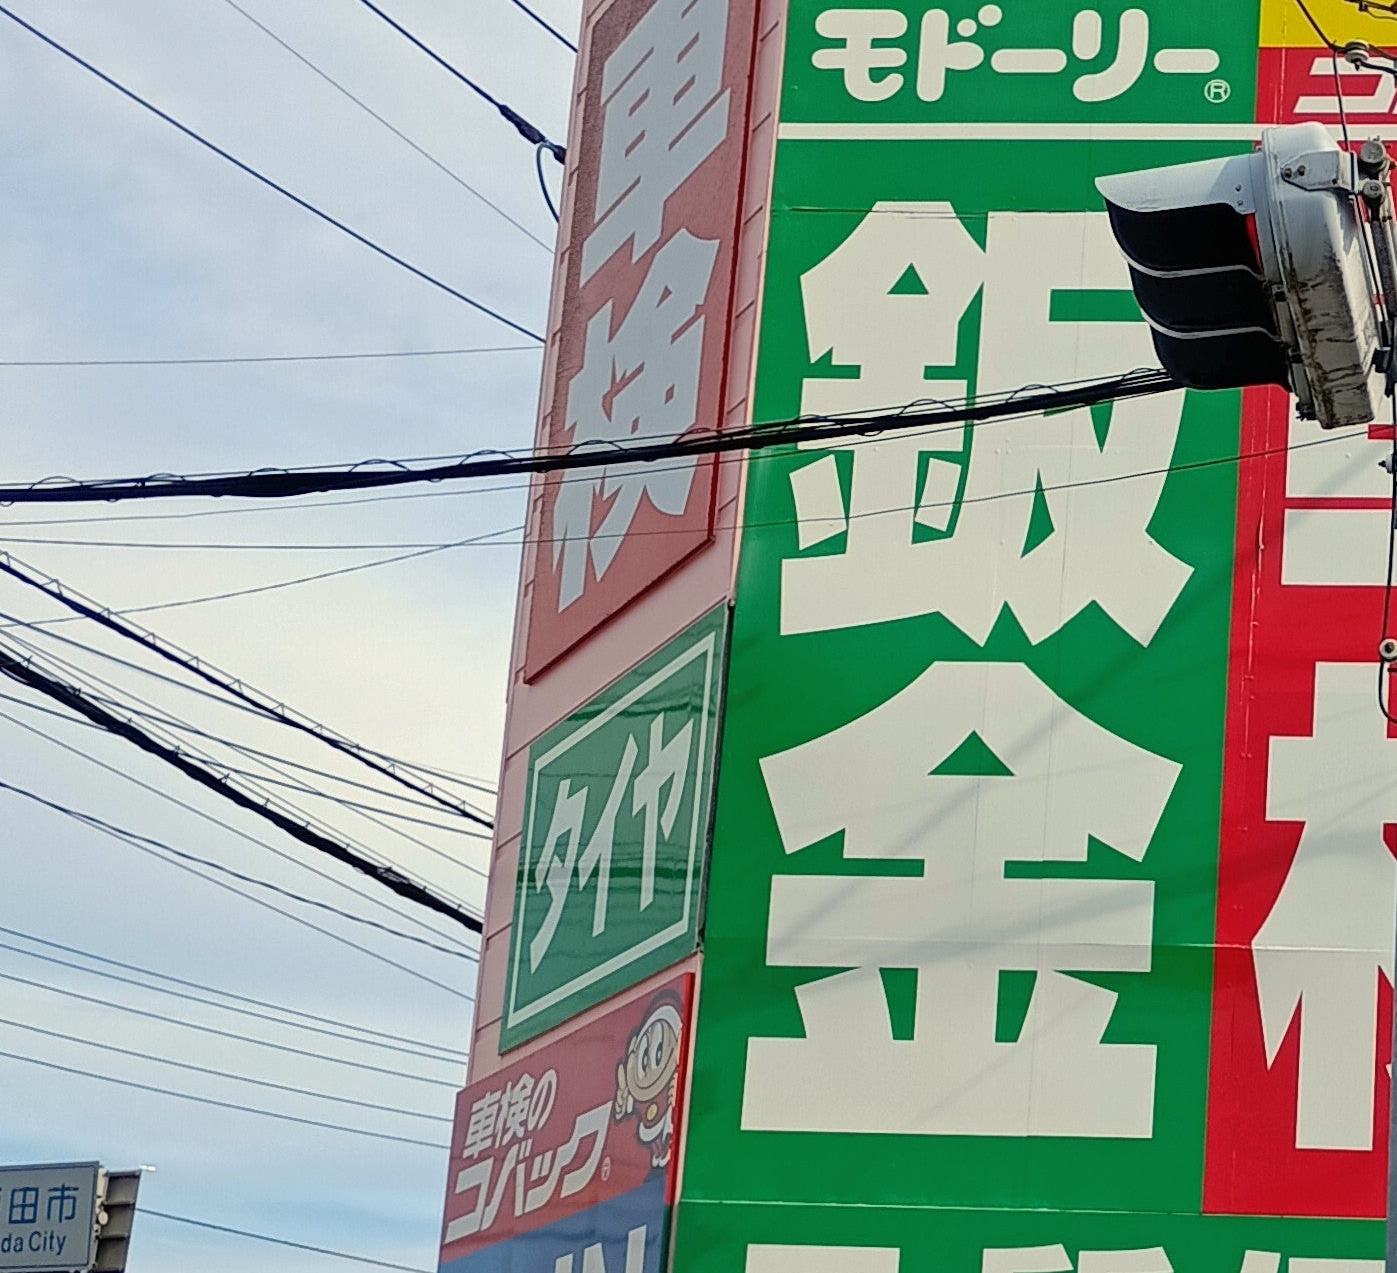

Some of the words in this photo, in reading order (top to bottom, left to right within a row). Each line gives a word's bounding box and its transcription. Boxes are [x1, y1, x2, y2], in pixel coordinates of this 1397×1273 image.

[812, 5, 1220, 103] モドーリー
[530, 711, 695, 974] タイヤ
[462, 1068, 558, 1160] 車検の
[0, 1183, 80, 1225] 田市
[444, 1100, 614, 1245] コバック
[28, 1230, 67, 1256] City
